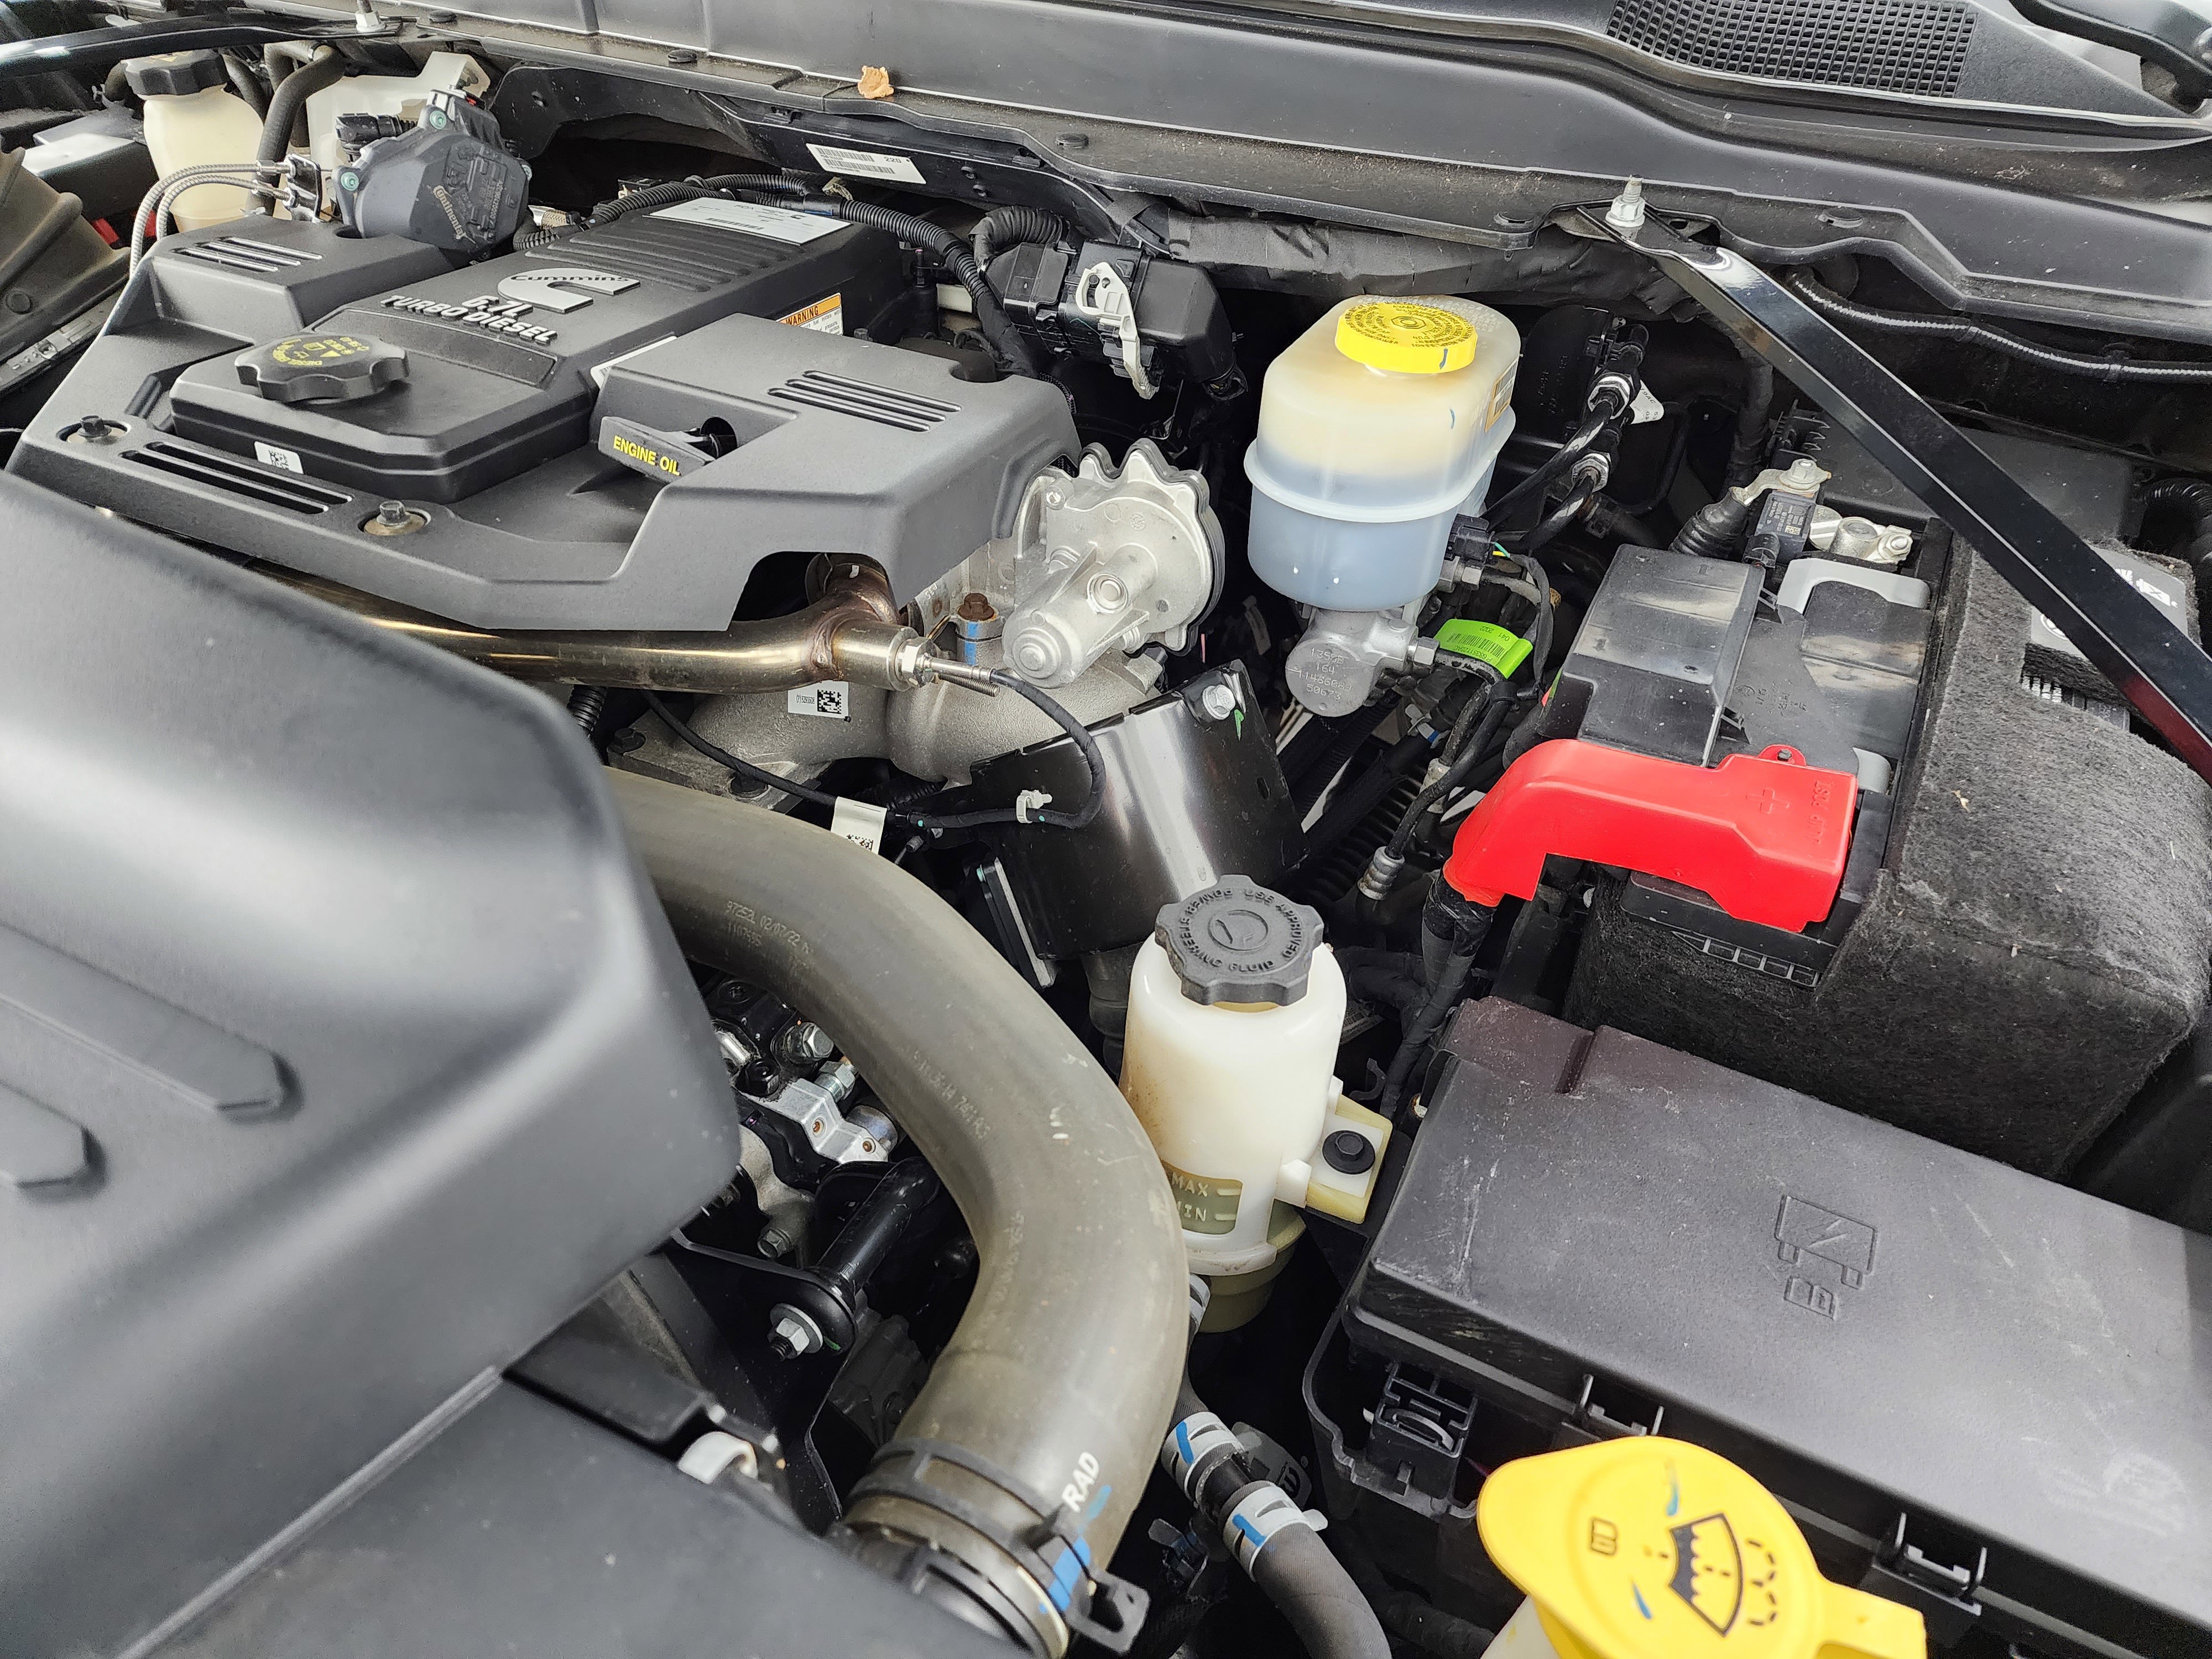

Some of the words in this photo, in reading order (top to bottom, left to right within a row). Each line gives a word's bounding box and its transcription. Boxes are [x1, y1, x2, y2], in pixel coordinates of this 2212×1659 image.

[510, 274, 630, 283] Cummins
[461, 294, 534, 319] 6.7L
[785, 305, 819, 325] WARNING
[380, 295, 469, 320] TURBO
[462, 311, 557, 345] DIESEL
[613, 435, 658, 466] ENGINE
[660, 456, 681, 477] OIL
[1316, 663, 1335, 675] 164
[1185, 888, 1234, 916] POWER
[1244, 889, 1275, 905] USE
[1179, 916, 1223, 968] STEERING
[1275, 904, 1302, 959] APPROVED
[1229, 959, 1274, 973] FLUID
[1172, 1171, 1208, 1197] MAX
[1061, 1451, 1100, 1514] RAD
